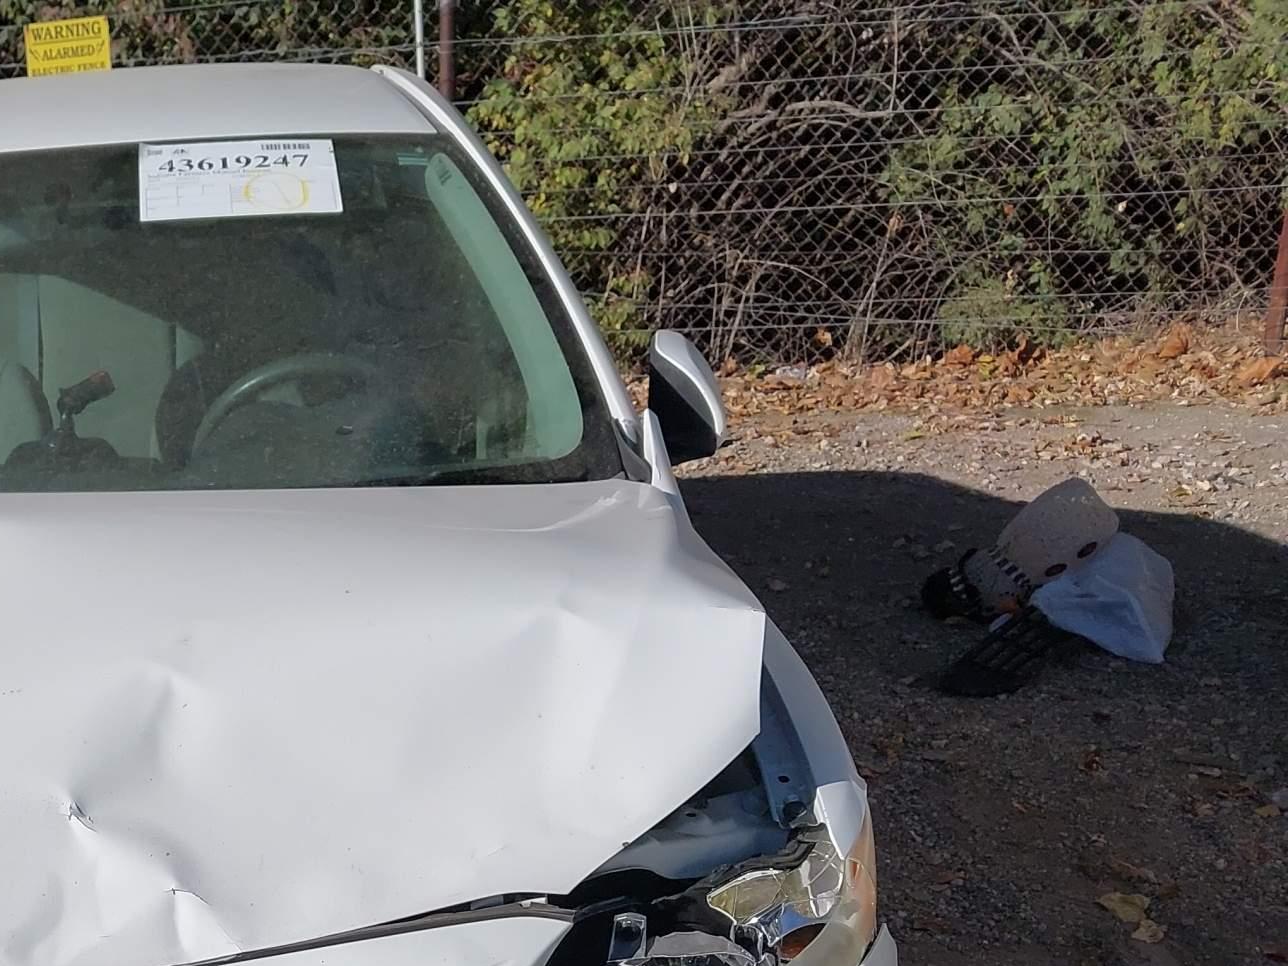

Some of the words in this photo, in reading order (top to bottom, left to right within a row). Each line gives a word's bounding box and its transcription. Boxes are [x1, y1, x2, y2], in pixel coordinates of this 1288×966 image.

[32, 20, 101, 41] WARNING
[43, 44, 95, 61] ALARMED
[158, 154, 309, 173] 43619247
